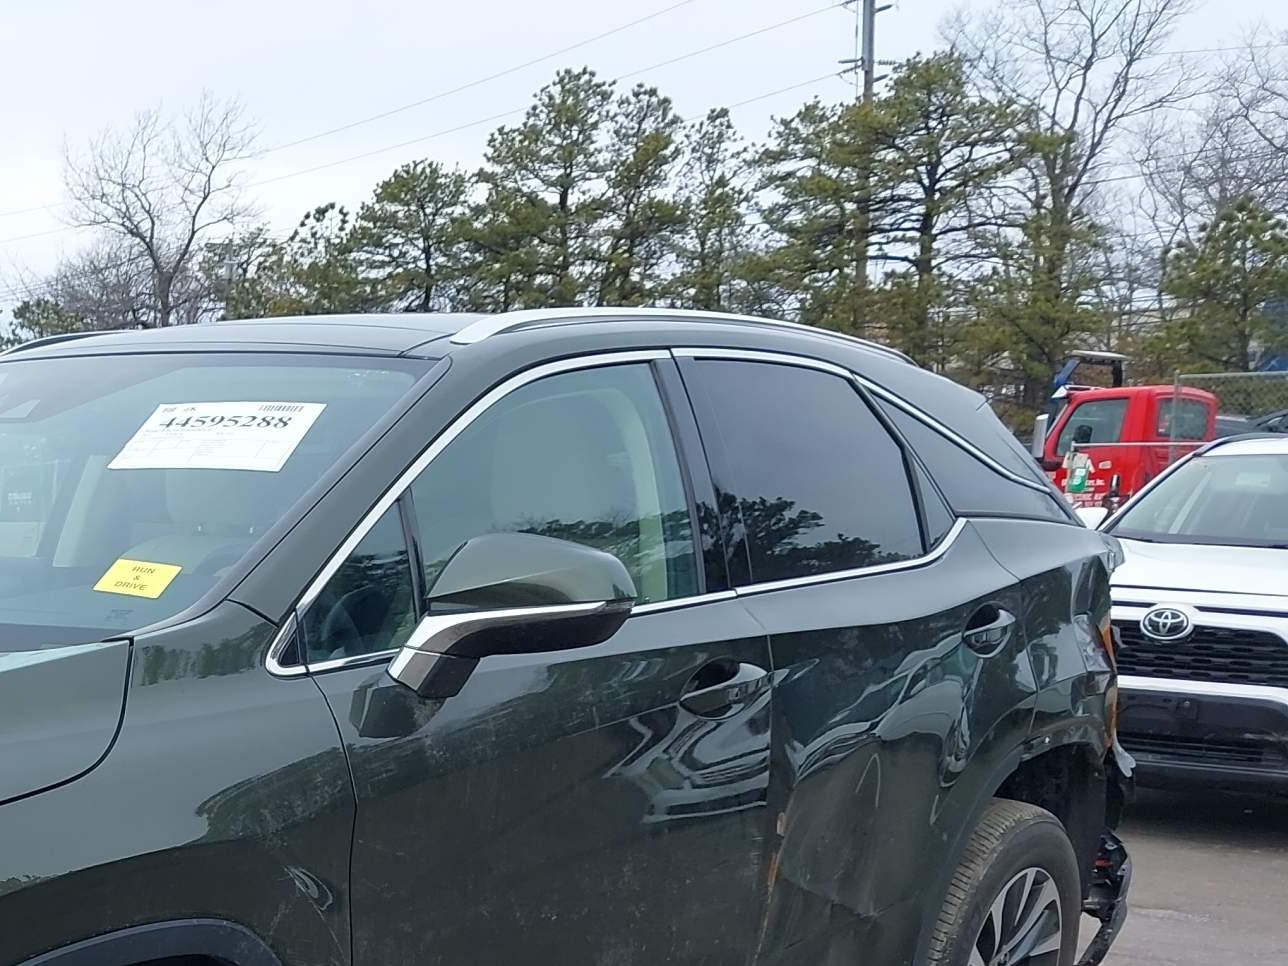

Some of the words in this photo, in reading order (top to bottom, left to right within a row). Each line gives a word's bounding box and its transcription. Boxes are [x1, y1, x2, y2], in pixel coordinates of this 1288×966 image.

[159, 415, 293, 430] 44595288
[132, 566, 155, 575] RUN
[114, 581, 149, 591] DRIVE
